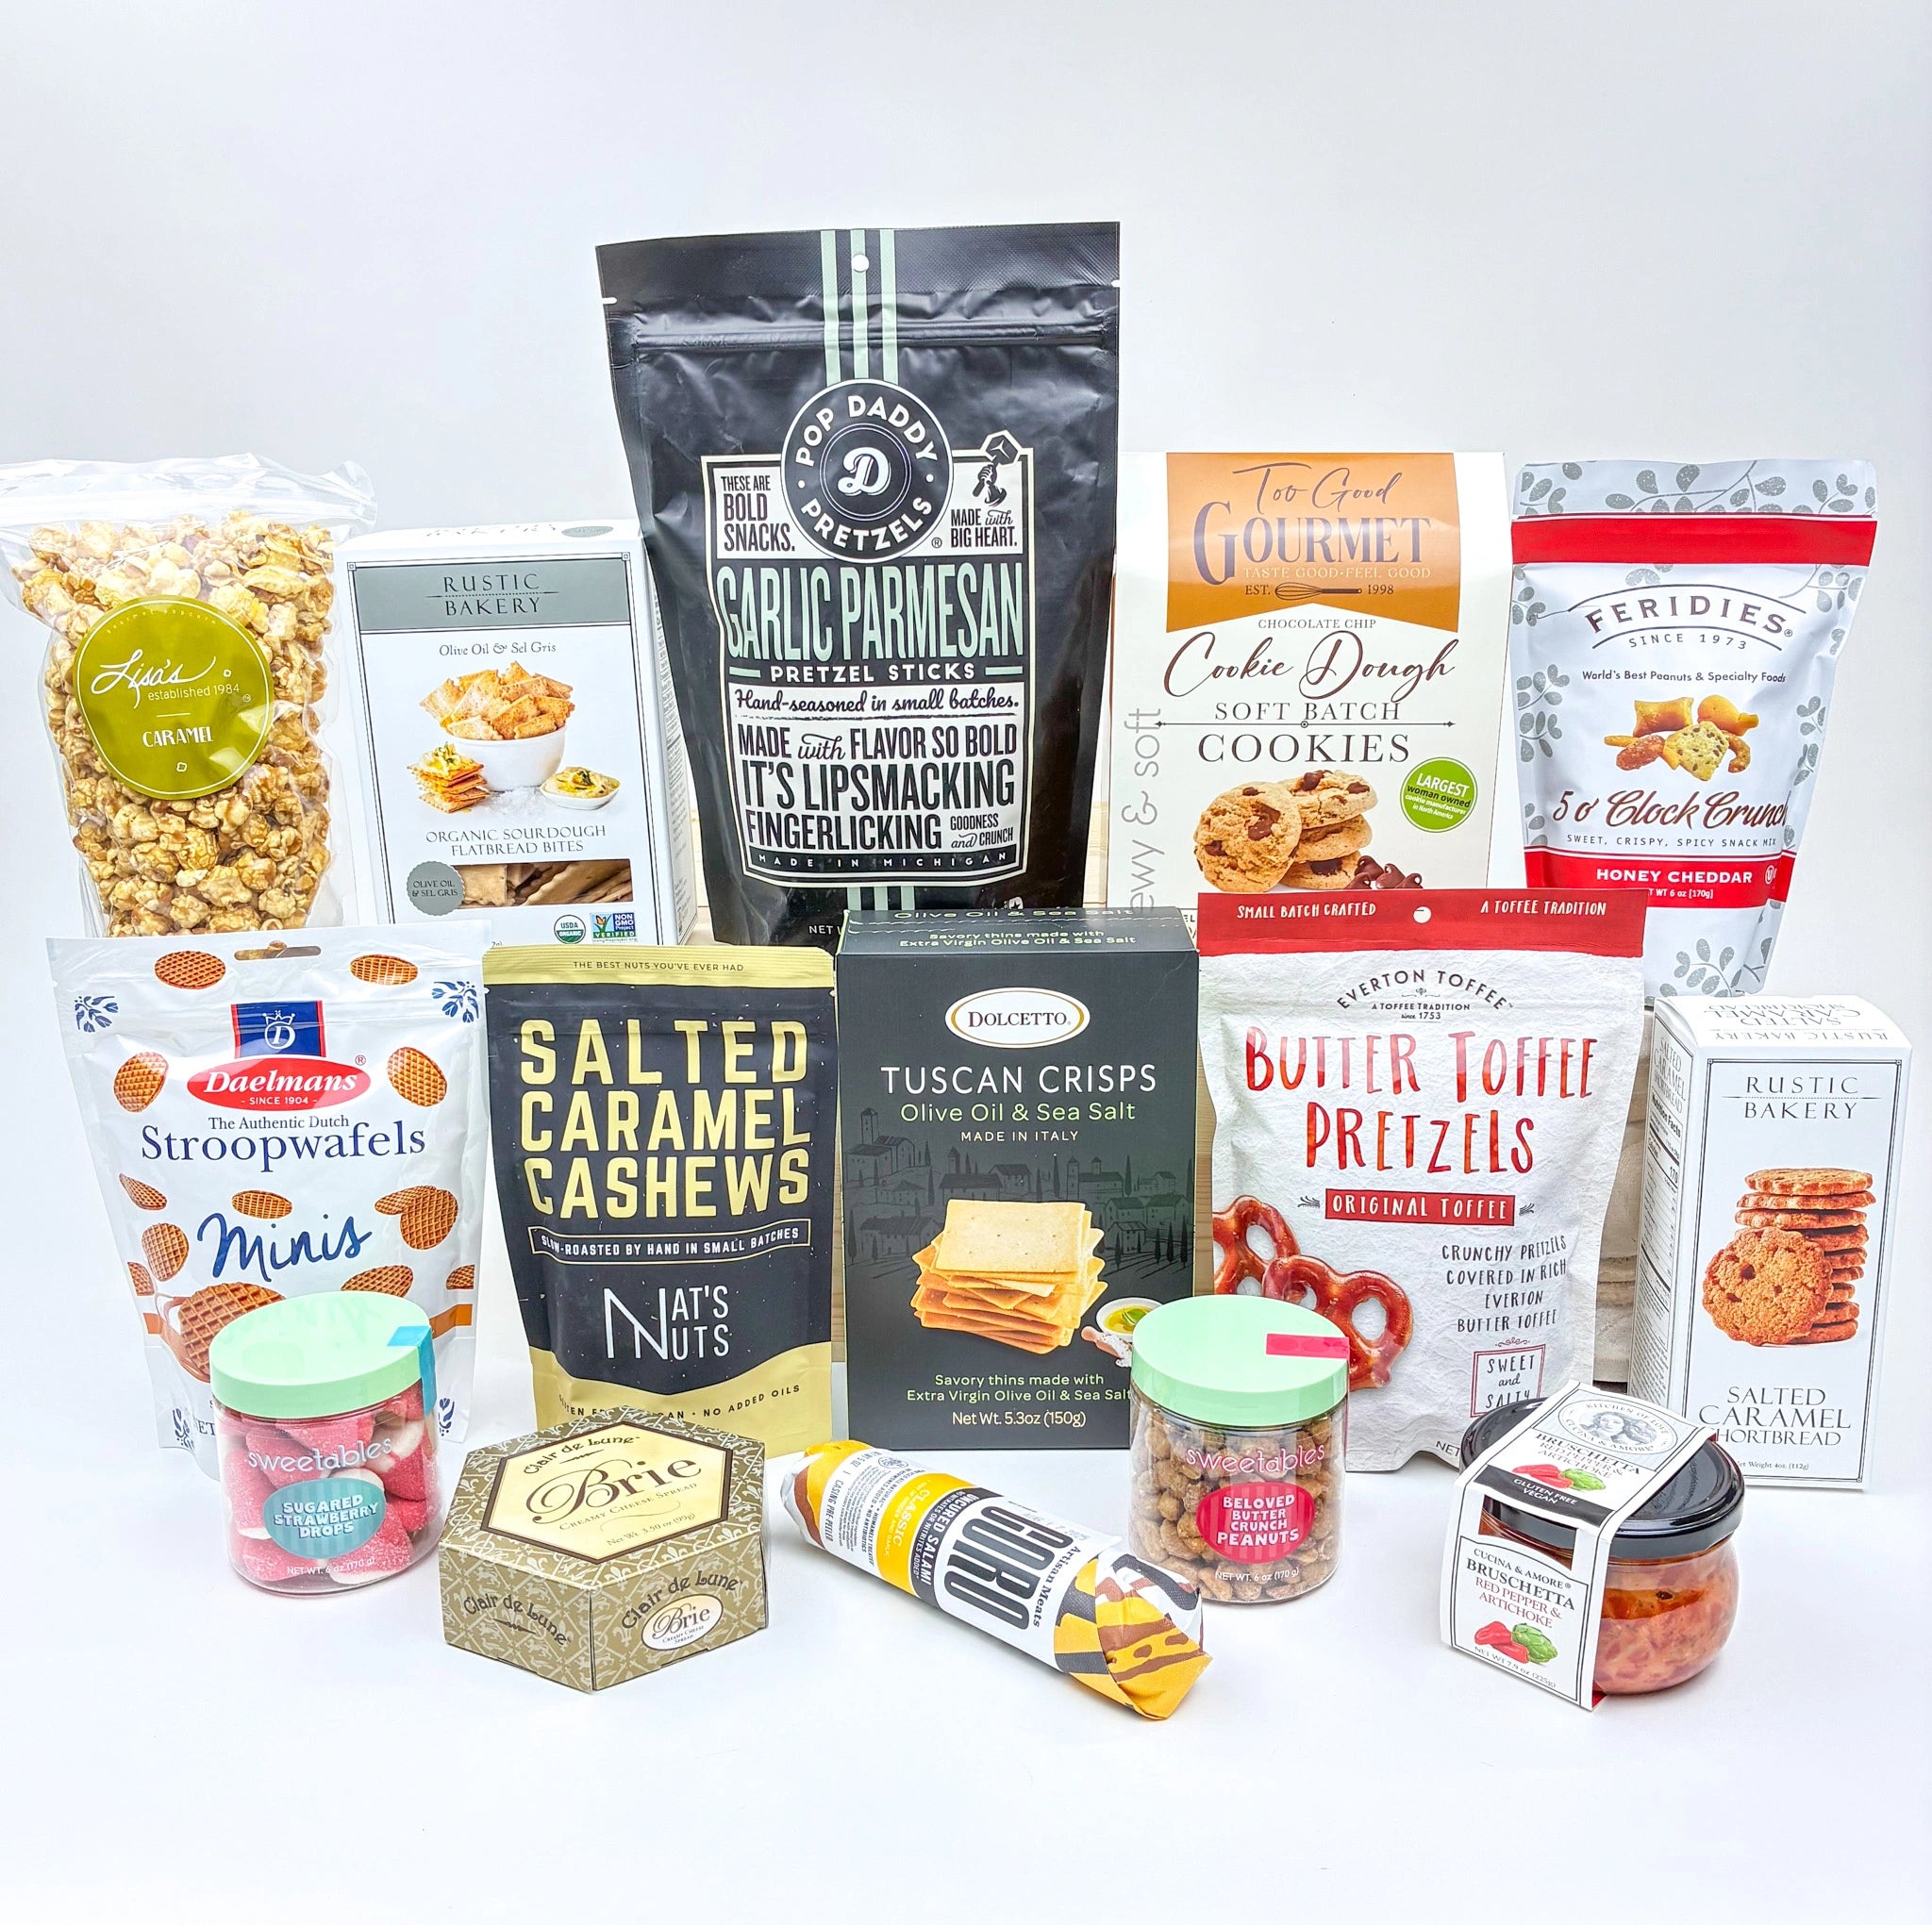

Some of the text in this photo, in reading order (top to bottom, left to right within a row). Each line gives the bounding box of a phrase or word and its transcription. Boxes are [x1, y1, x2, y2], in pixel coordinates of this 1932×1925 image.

[795, 395, 938, 466] POP DADDY
[722, 475, 771, 491] THESE ARE
[1232, 461, 1403, 513] Too Good
[724, 493, 767, 522] BOLD
[801, 497, 932, 551] PRETZELS
[724, 523, 795, 552] SNACKS.
[951, 527, 1017, 548] BIG HEART.
[1192, 502, 1431, 586] GOURMET
[443, 573, 540, 592] RUSTIC
[1244, 584, 1393, 596] EST. 1998
[445, 597, 540, 616] BAKERY
[717, 563, 1023, 661] GARLIC PARMESAN
[1585, 595, 1787, 635] FERIDIES
[1258, 619, 1376, 629] CHOCOLATE CHIP
[1629, 633, 1747, 650] SINCE 1973
[771, 663, 974, 683] PRETZEL STICKS
[1163, 630, 1459, 701] Cookie Dough
[1582, 671, 1786, 684] World's Best Peanuts & Specialty Foods
[148, 684, 240, 700] established 1984
[735, 688, 1019, 712] Hand-seasoned in small batches.
[1214, 702, 1401, 721] SOFT BATCH
[142, 726, 213, 747] CARAMEL
[738, 723, 1017, 760] MADE with FLAVOR SO BOLD
[1124, 707, 1162, 776] soft
[1198, 733, 1409, 763] COOKIES
[742, 760, 794, 810] IT'S
[802, 759, 1015, 811] LIPSMACKING
[1407, 786, 1471, 807] woman owned
[1416, 772, 1470, 797] LARGEST
[425, 825, 606, 844] ORGANIC SOURDOUGH
[746, 813, 941, 850] FINGERLICKING
[950, 814, 998, 831] GOODNESS
[451, 840, 584, 856] FLATBREAD BITES
[951, 827, 1013, 848] and CRUNCH
[758, 853, 1007, 867] MADE IN MICHIGAN
[1596, 869, 1752, 884] HONEY CHEDDAR
[1238, 903, 1376, 919] SMALL BATCH CRAFTED
[809, 925, 833, 935] NET
[1337, 970, 1508, 1010] EVERTON TOFFEE
[968, 1011, 1067, 1028] DOLCETTO
[520, 1019, 808, 1085] SALTED
[1246, 1026, 1598, 1103] BUTTER TOFFEE
[204, 1066, 358, 1093] Daelmans
[880, 1064, 1157, 1095] TUSCAN CRISPS
[1746, 1076, 1859, 1094] RUSTIC
[208, 1115, 349, 1129] The Authentic Dutch
[521, 1087, 810, 1152] CARAMEL
[900, 1101, 1136, 1122] Olive Oil & Sea Salt
[1744, 1103, 1857, 1120] BAKERY
[142, 1120, 425, 1172] Stroopwafels
[961, 1131, 1078, 1142] MADE IN ITALY
[1306, 1102, 1534, 1174] PRETZELS
[525, 1149, 809, 1220] CASHEWS
[1332, 1196, 1507, 1220] ORIGINAL TOFFEE
[1441, 1235, 1566, 1262] CRUNCHY PRETZELS
[1446, 1260, 1566, 1285] COVERED IN RICH
[1485, 1291, 1543, 1308] EVERTON
[1457, 1309, 1557, 1332] BUTTER TOFFEE
[1487, 1354, 1534, 1373] SWEET
[935, 1374, 1104, 1387] Savory thins made with
[703, 1385, 800, 1418] NO ADDED OILS
[1727, 1386, 1825, 1405] SALTED
[1699, 1404, 1851, 1429] CARAMEL
[1717, 1428, 1840, 1446] HORTBREAD
[248, 1438, 392, 1471] sweetables
[1186, 1445, 1325, 1473] sweetables
[1436, 1441, 1460, 1458] NET
[525, 1460, 702, 1525] Brie
[1223, 1494, 1295, 1509] BELOVED
[1514, 1478, 1577, 1505] GLUTEN FREE
[1522, 1487, 1559, 1504] VEGAN
[274, 1502, 378, 1526] STRAWBERRY
[282, 1494, 364, 1514] SUGARED
[559, 1483, 697, 1531] CREAMY CHEESE SPREAD
[1232, 1509, 1286, 1521] BUTTER
[298, 1524, 355, 1538] DROPS
[1230, 1518, 1288, 1532] CRUNCH
[1217, 1529, 1299, 1547] PEANUTS
[943, 1504, 1074, 1631] CORO
[1032, 1546, 1082, 1627] Artisan Meats
[1466, 1557, 1575, 1611] BRUSCHETTA
[622, 1570, 738, 1630] Clair de Lune
[1474, 1576, 1562, 1619] RED PEPPER &
[1478, 1590, 1553, 1629] ARTICHOKE
[652, 1603, 710, 1639] Brie
